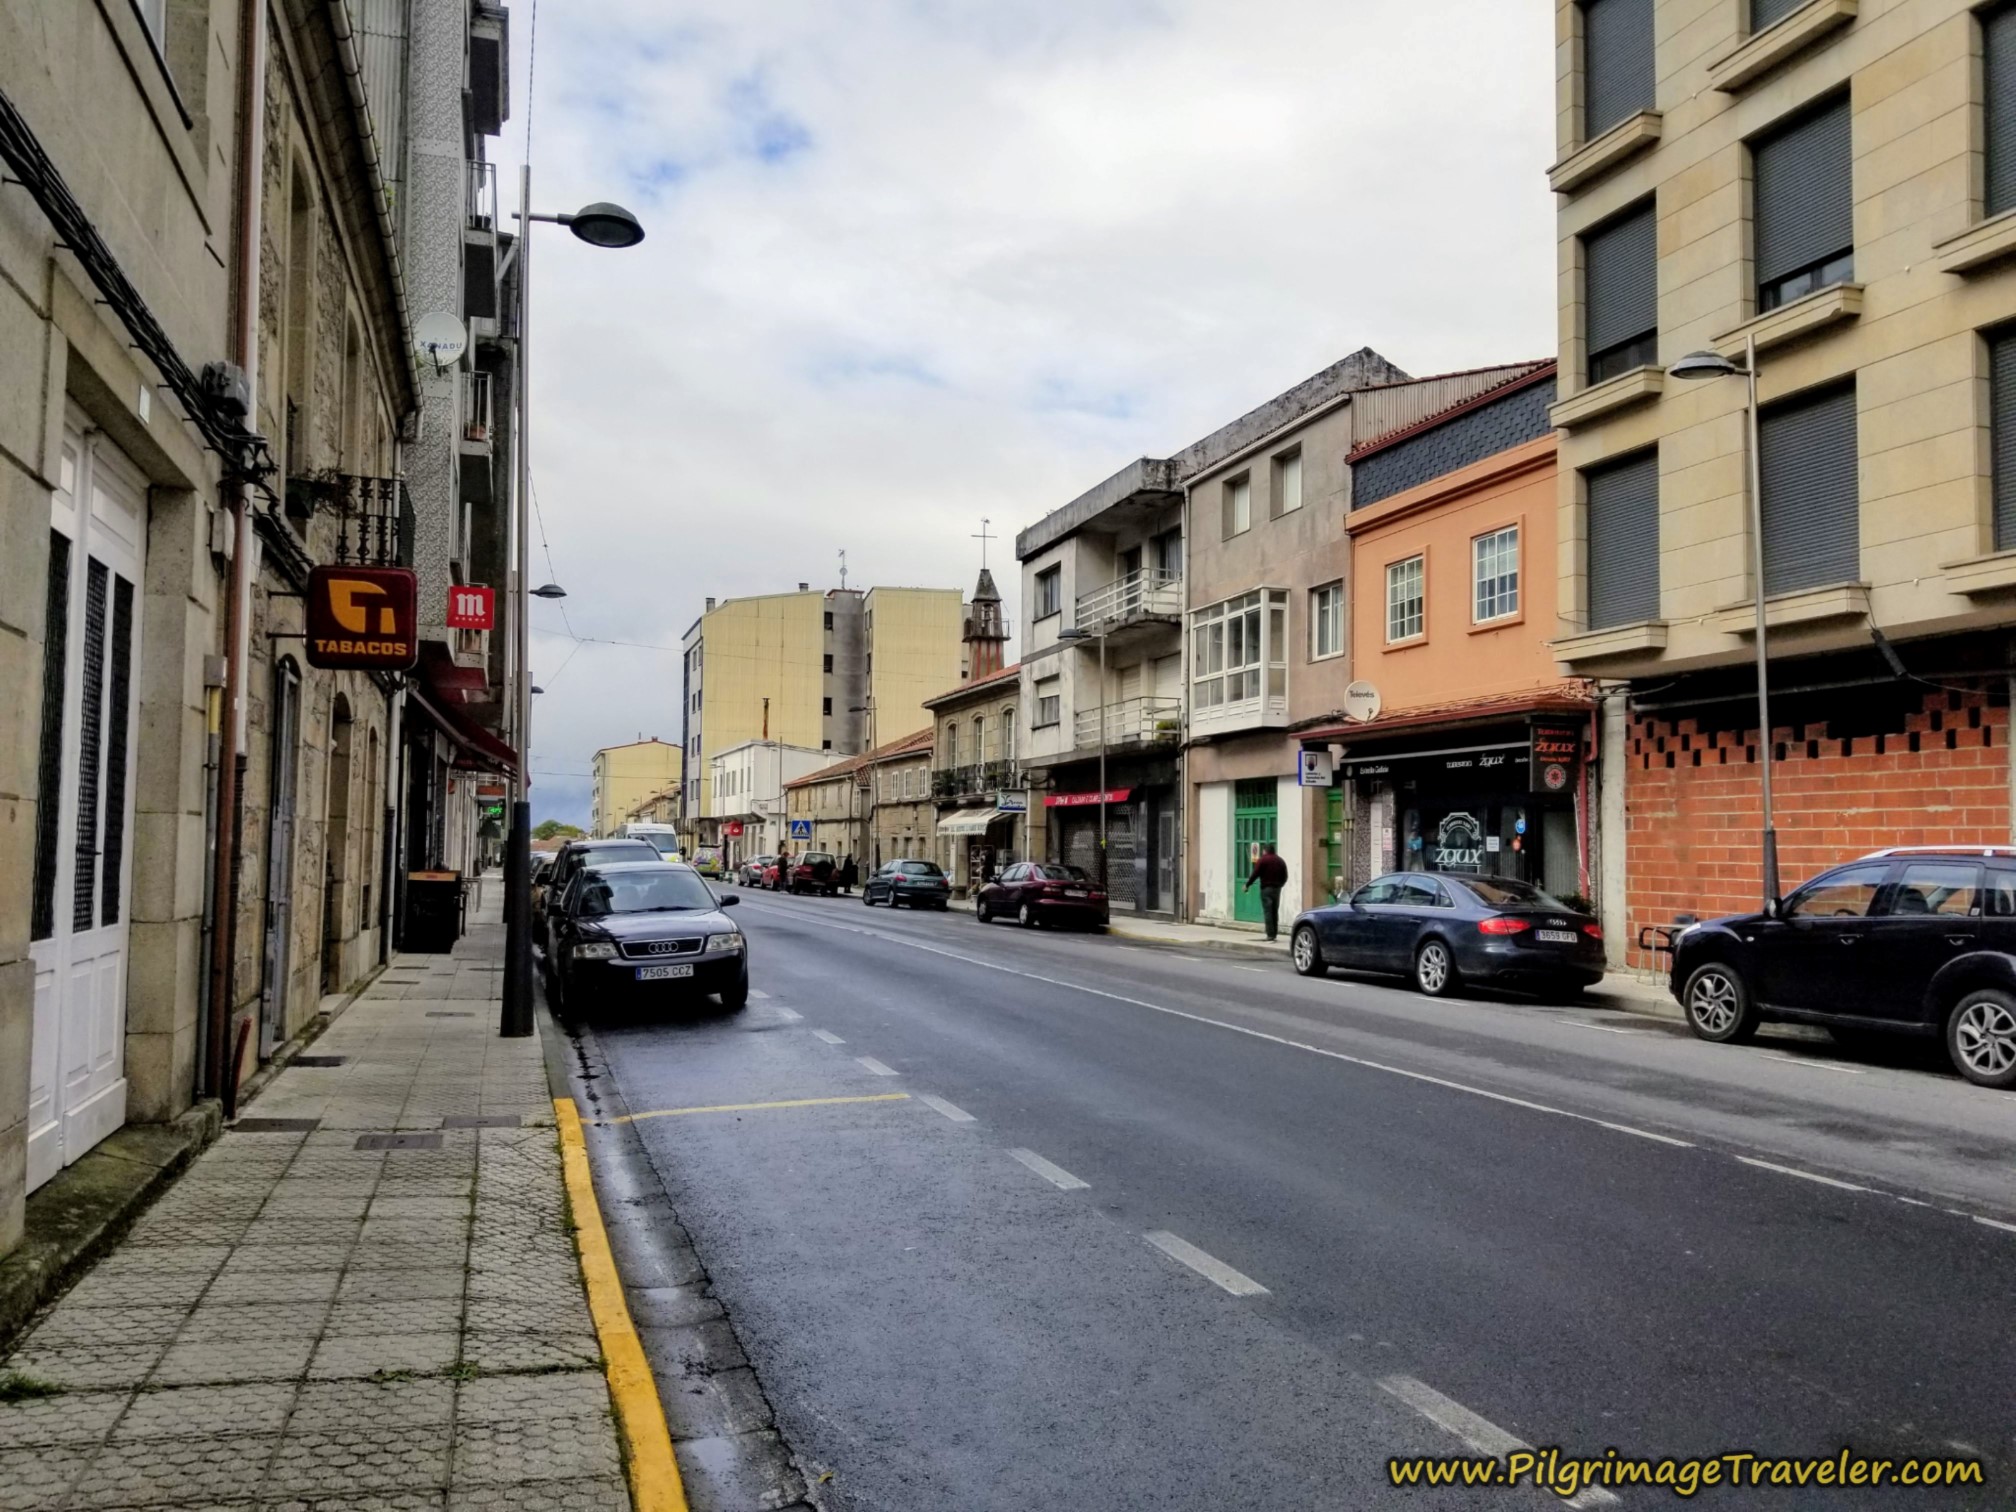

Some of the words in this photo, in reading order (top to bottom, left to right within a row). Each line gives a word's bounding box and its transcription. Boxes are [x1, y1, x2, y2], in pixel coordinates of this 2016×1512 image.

[315, 639, 407, 656] TABACOS
[1349, 690, 1375, 698] Televés
[643, 967, 669, 978] 7505
[672, 965, 691, 977] CCZ
